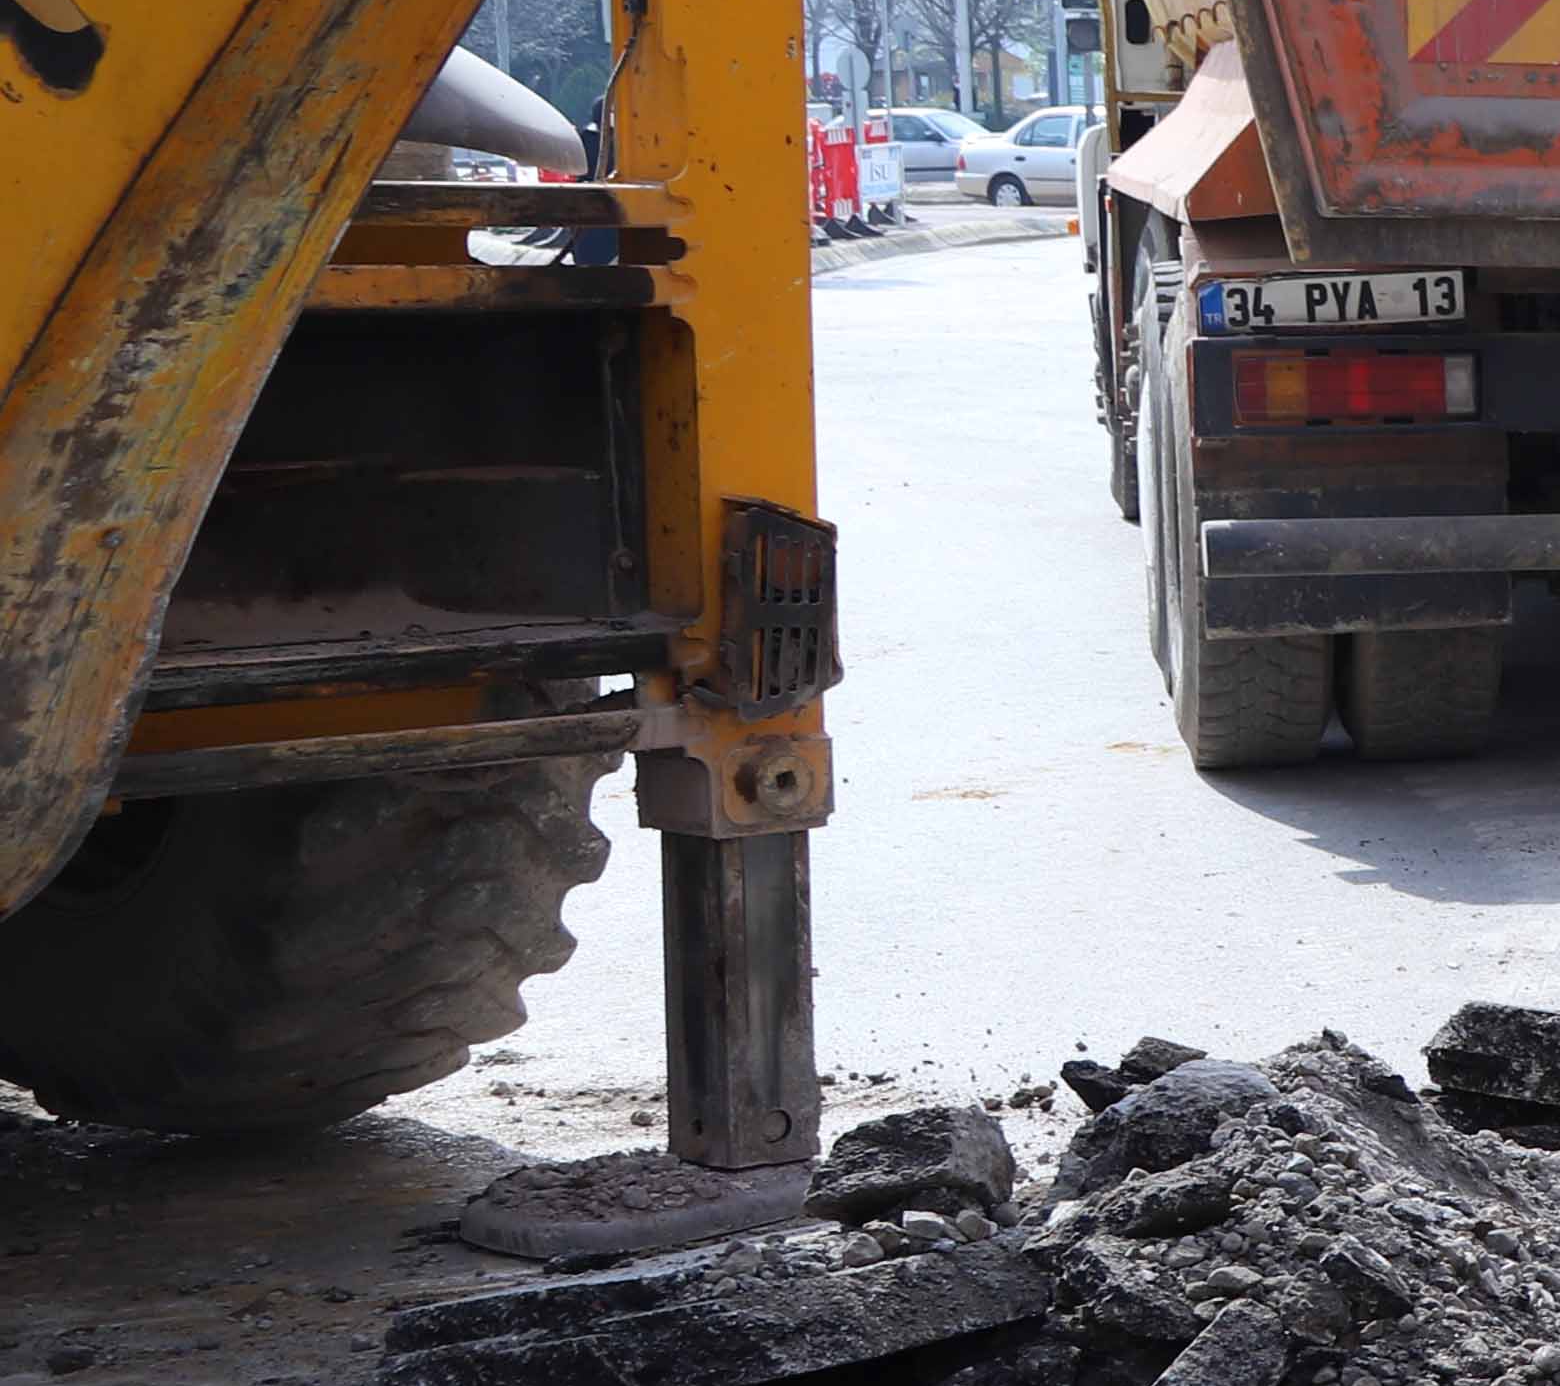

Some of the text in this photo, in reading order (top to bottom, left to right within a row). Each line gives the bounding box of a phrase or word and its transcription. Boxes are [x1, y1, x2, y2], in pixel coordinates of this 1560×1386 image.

[1226, 286, 1275, 328] 34
[1304, 280, 1379, 323] PYA
[1412, 276, 1457, 317] 13
